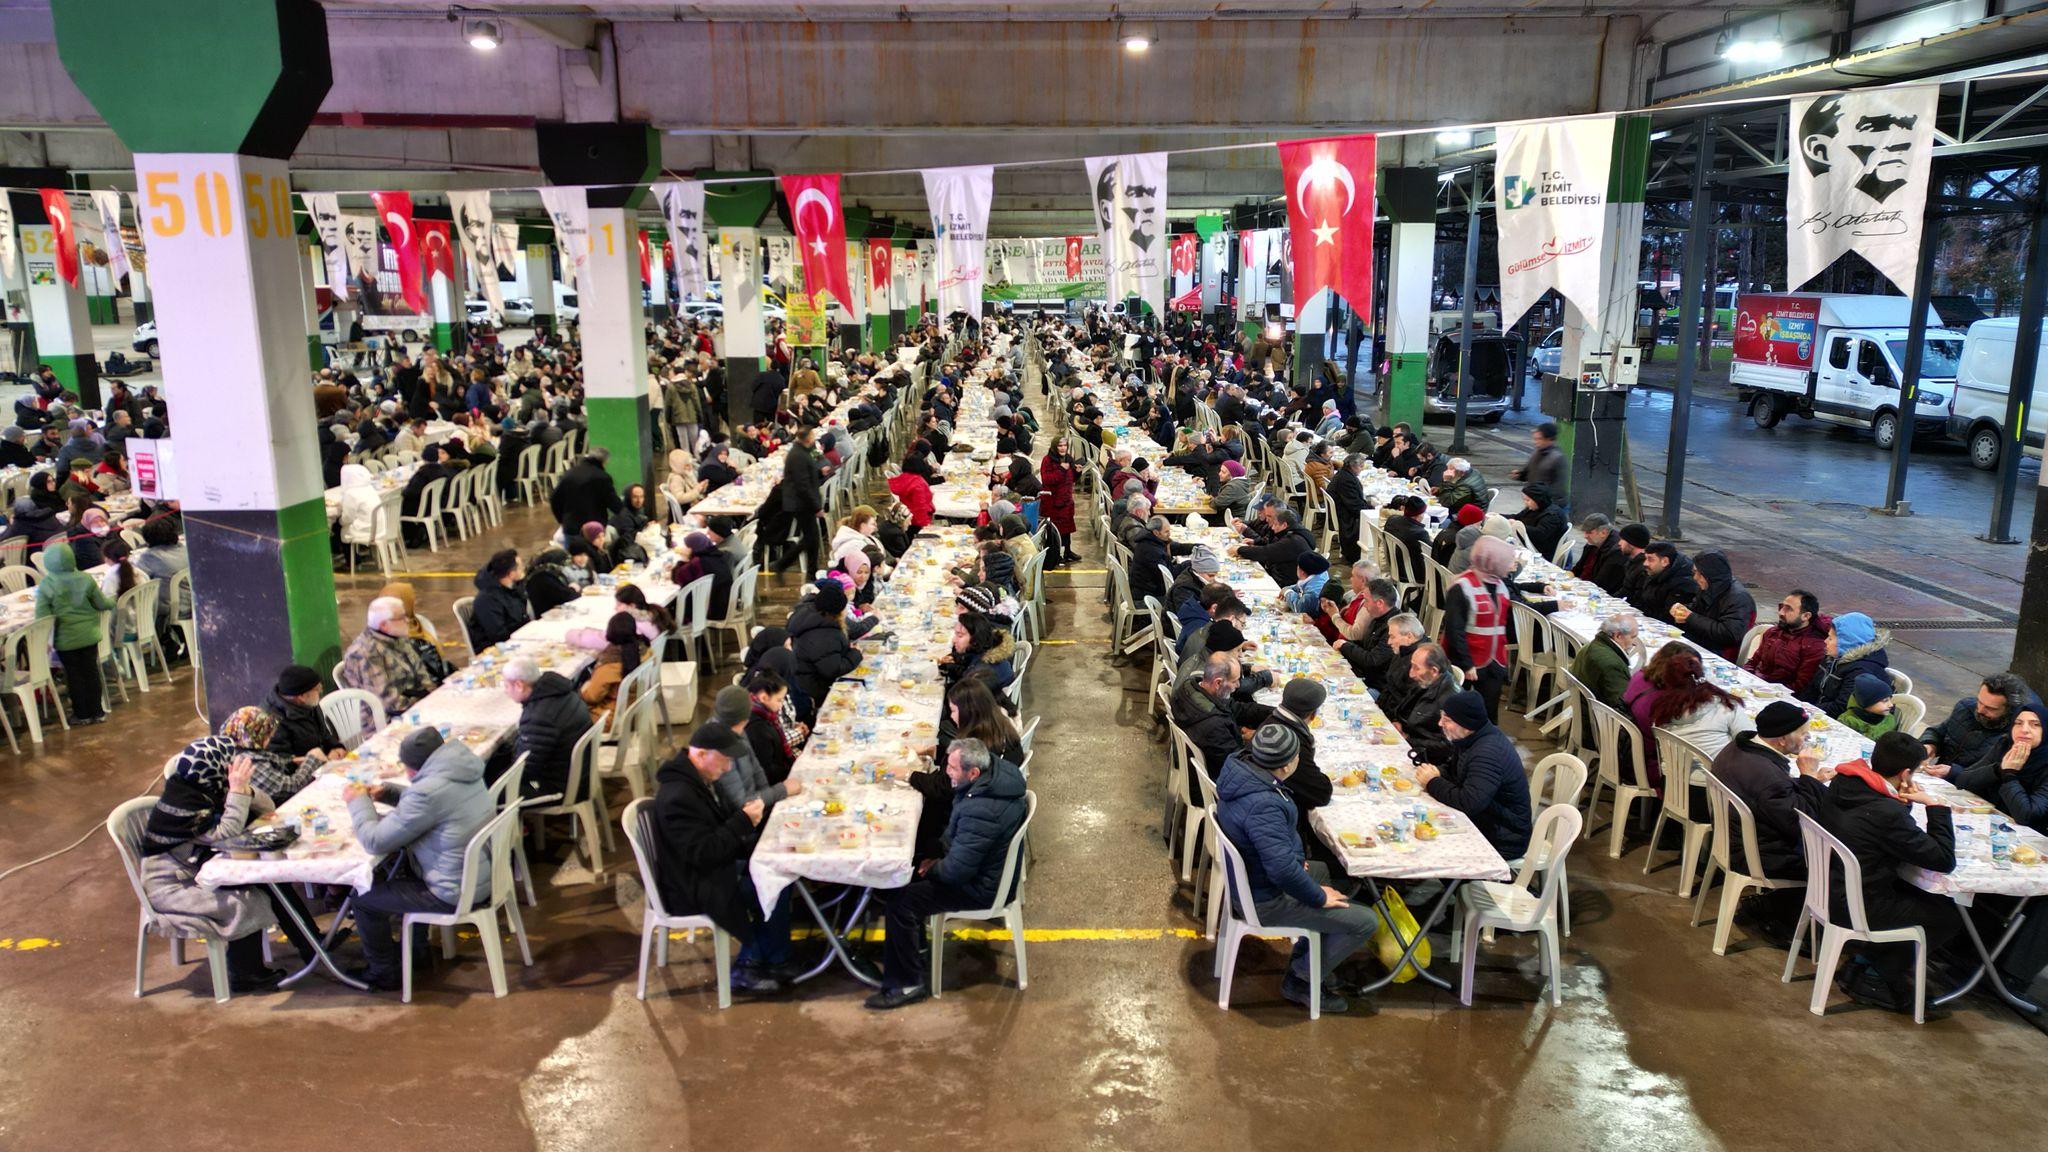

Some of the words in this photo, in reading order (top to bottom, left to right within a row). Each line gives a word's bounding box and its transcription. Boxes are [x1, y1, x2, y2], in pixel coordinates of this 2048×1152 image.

[1541, 171, 1565, 180] T.C.
[1541, 180, 1573, 194] İZMİT
[144, 171, 233, 238] 50
[244, 172, 292, 239] 50
[1541, 193, 1601, 206] BELEDİYESİ
